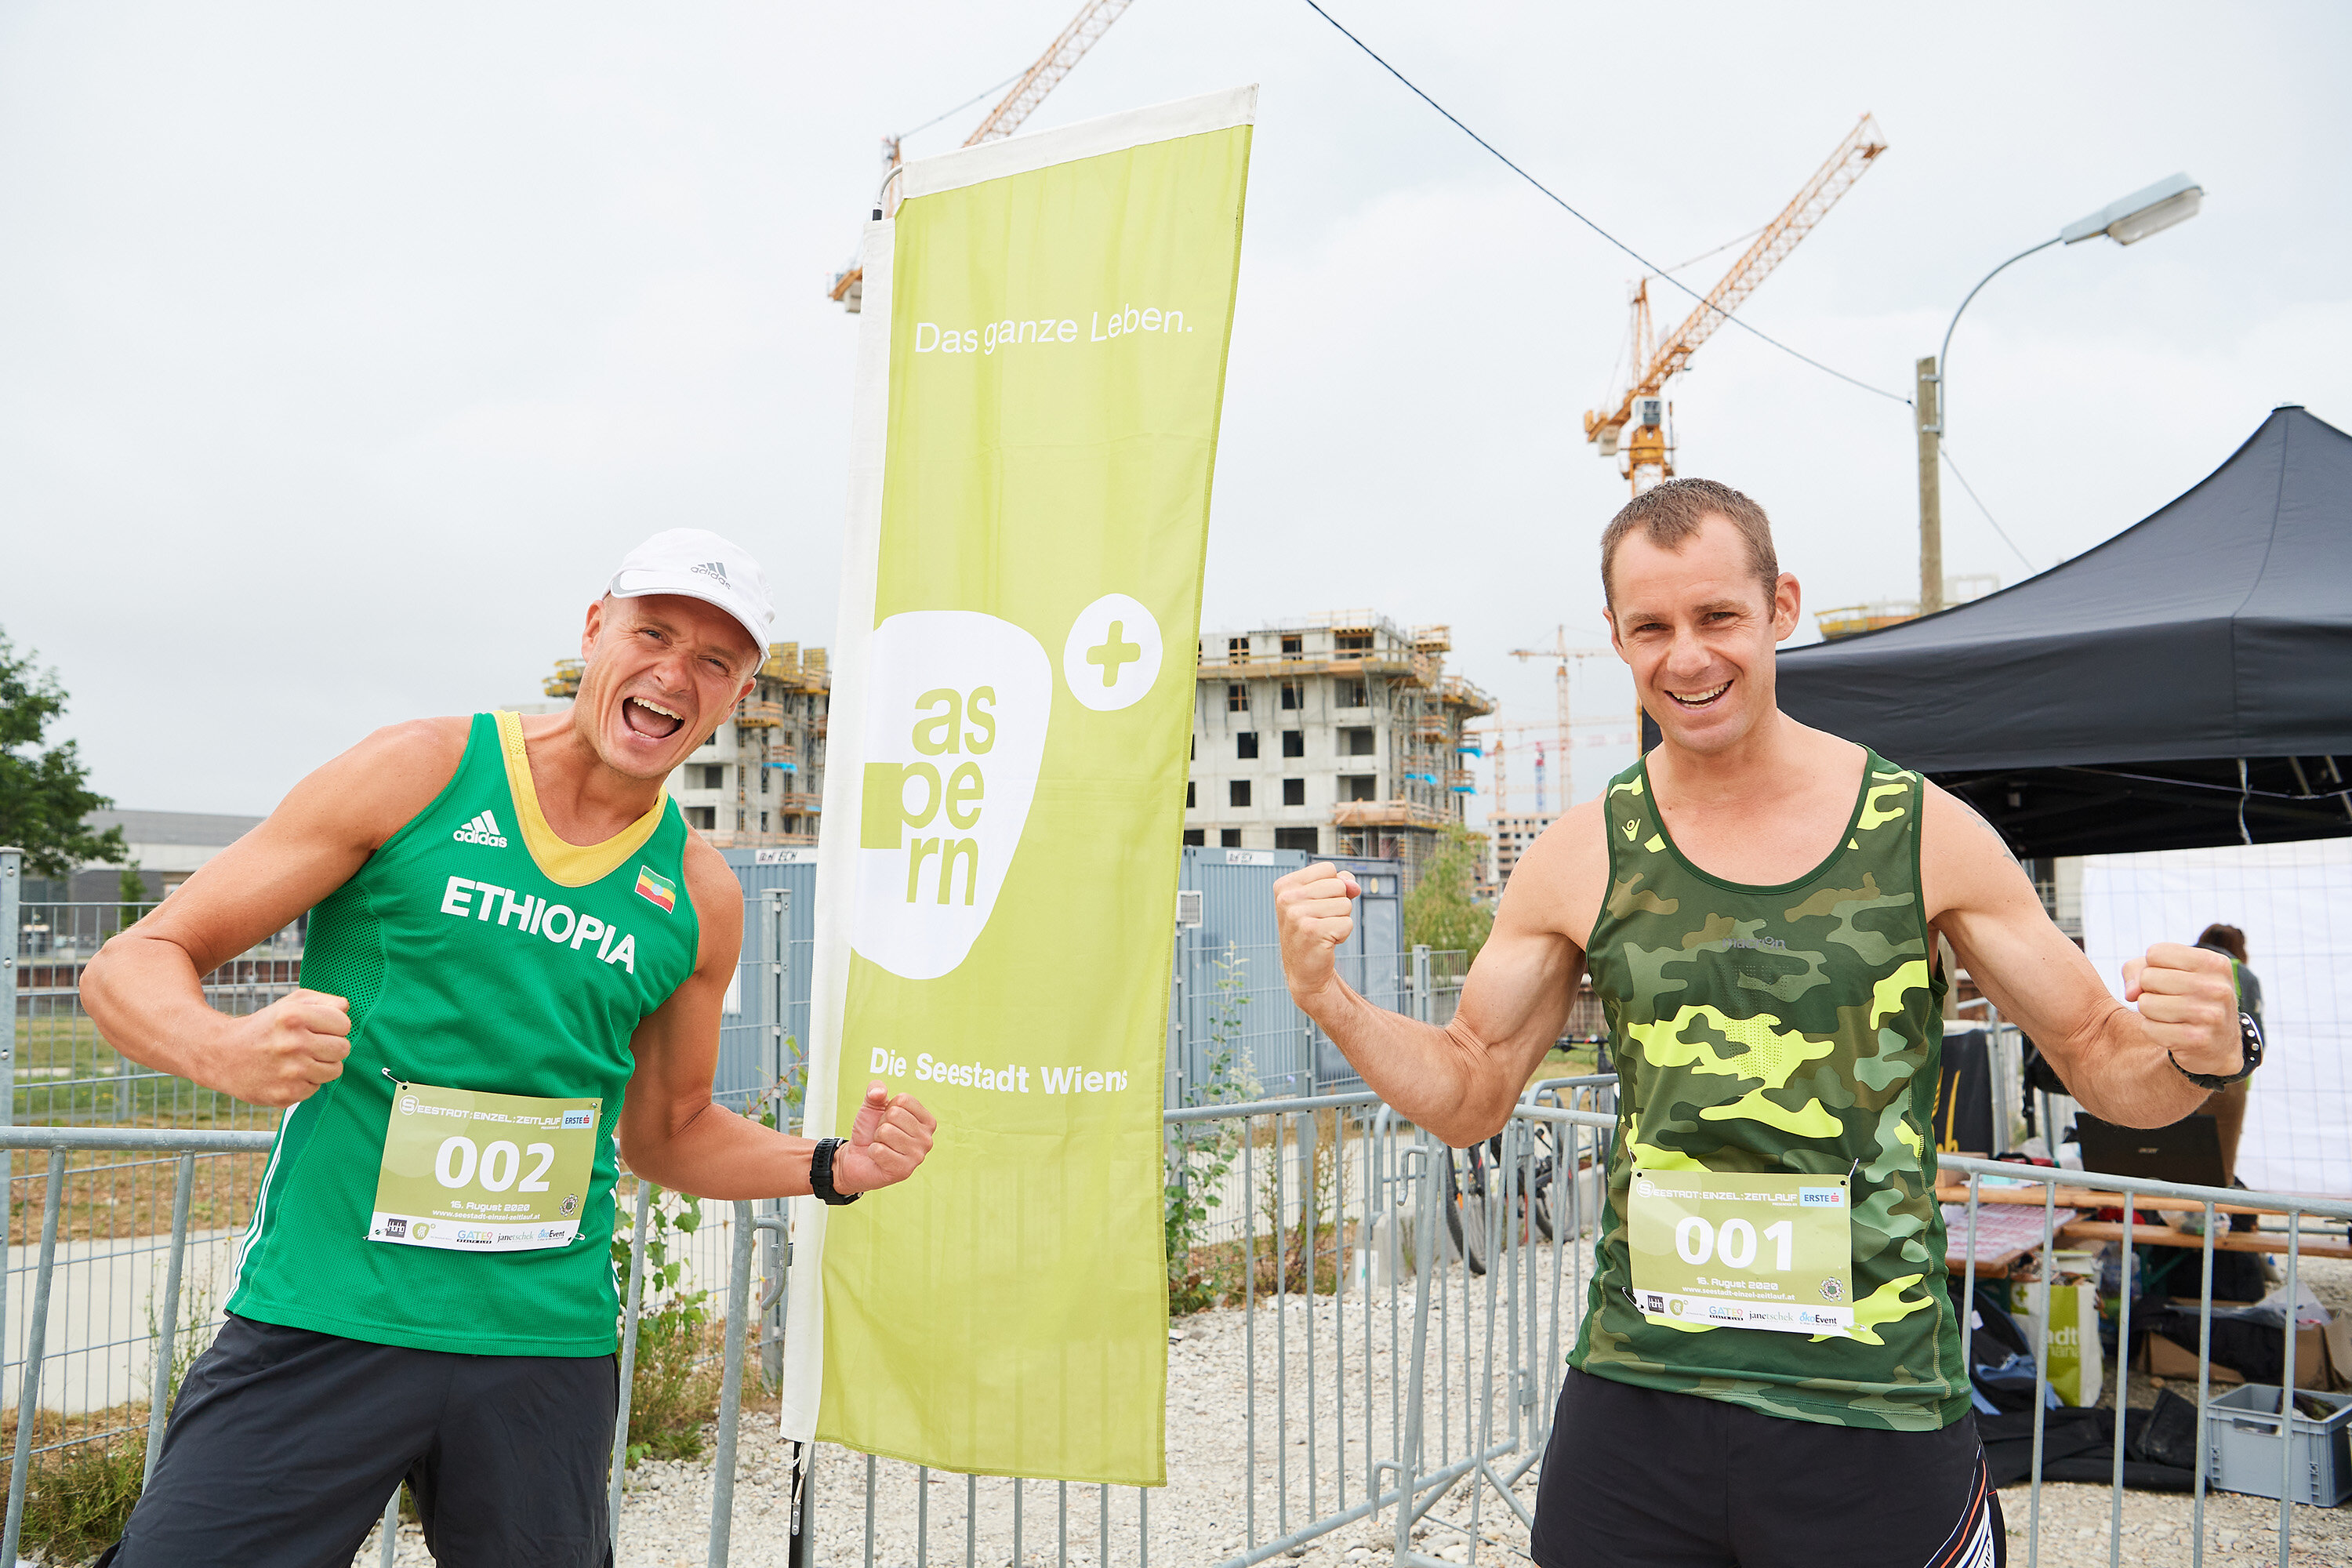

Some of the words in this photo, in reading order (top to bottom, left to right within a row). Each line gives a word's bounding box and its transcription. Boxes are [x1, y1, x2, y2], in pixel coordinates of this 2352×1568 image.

[915, 322, 978, 354] Das
[984, 318, 1078, 355] ganze
[1091, 303, 1193, 343] Leben.
[690, 567, 731, 590] adidas
[912, 685, 996, 756] as
[453, 829, 508, 848] adidas
[906, 837, 979, 906] rn
[441, 875, 635, 975] ETHIOPIA
[1722, 936, 1785, 950] macron
[869, 1047, 907, 1077] Die
[915, 1053, 1029, 1093] Seestadt
[1040, 1065, 1128, 1094] Wiens
[434, 1136, 555, 1192] 002
[1804, 1194, 1830, 1203] ERSTE
[466, 1201, 502, 1213] August
[504, 1203, 531, 1212] 2020
[433, 1210, 540, 1221] www.seestadt-einzel-zeitlauf.at
[497, 1231, 534, 1243] janetschek
[538, 1229, 565, 1239] ökoEvent
[1675, 1216, 1793, 1272] 001
[1711, 1278, 1746, 1290] August
[1748, 1281, 1779, 1291] 2020
[1682, 1287, 1795, 1301] www.seestadt-einzel-zeitlauf.at
[1749, 1310, 1794, 1322] janetschek
[1799, 1311, 1838, 1324] ökoEvent
